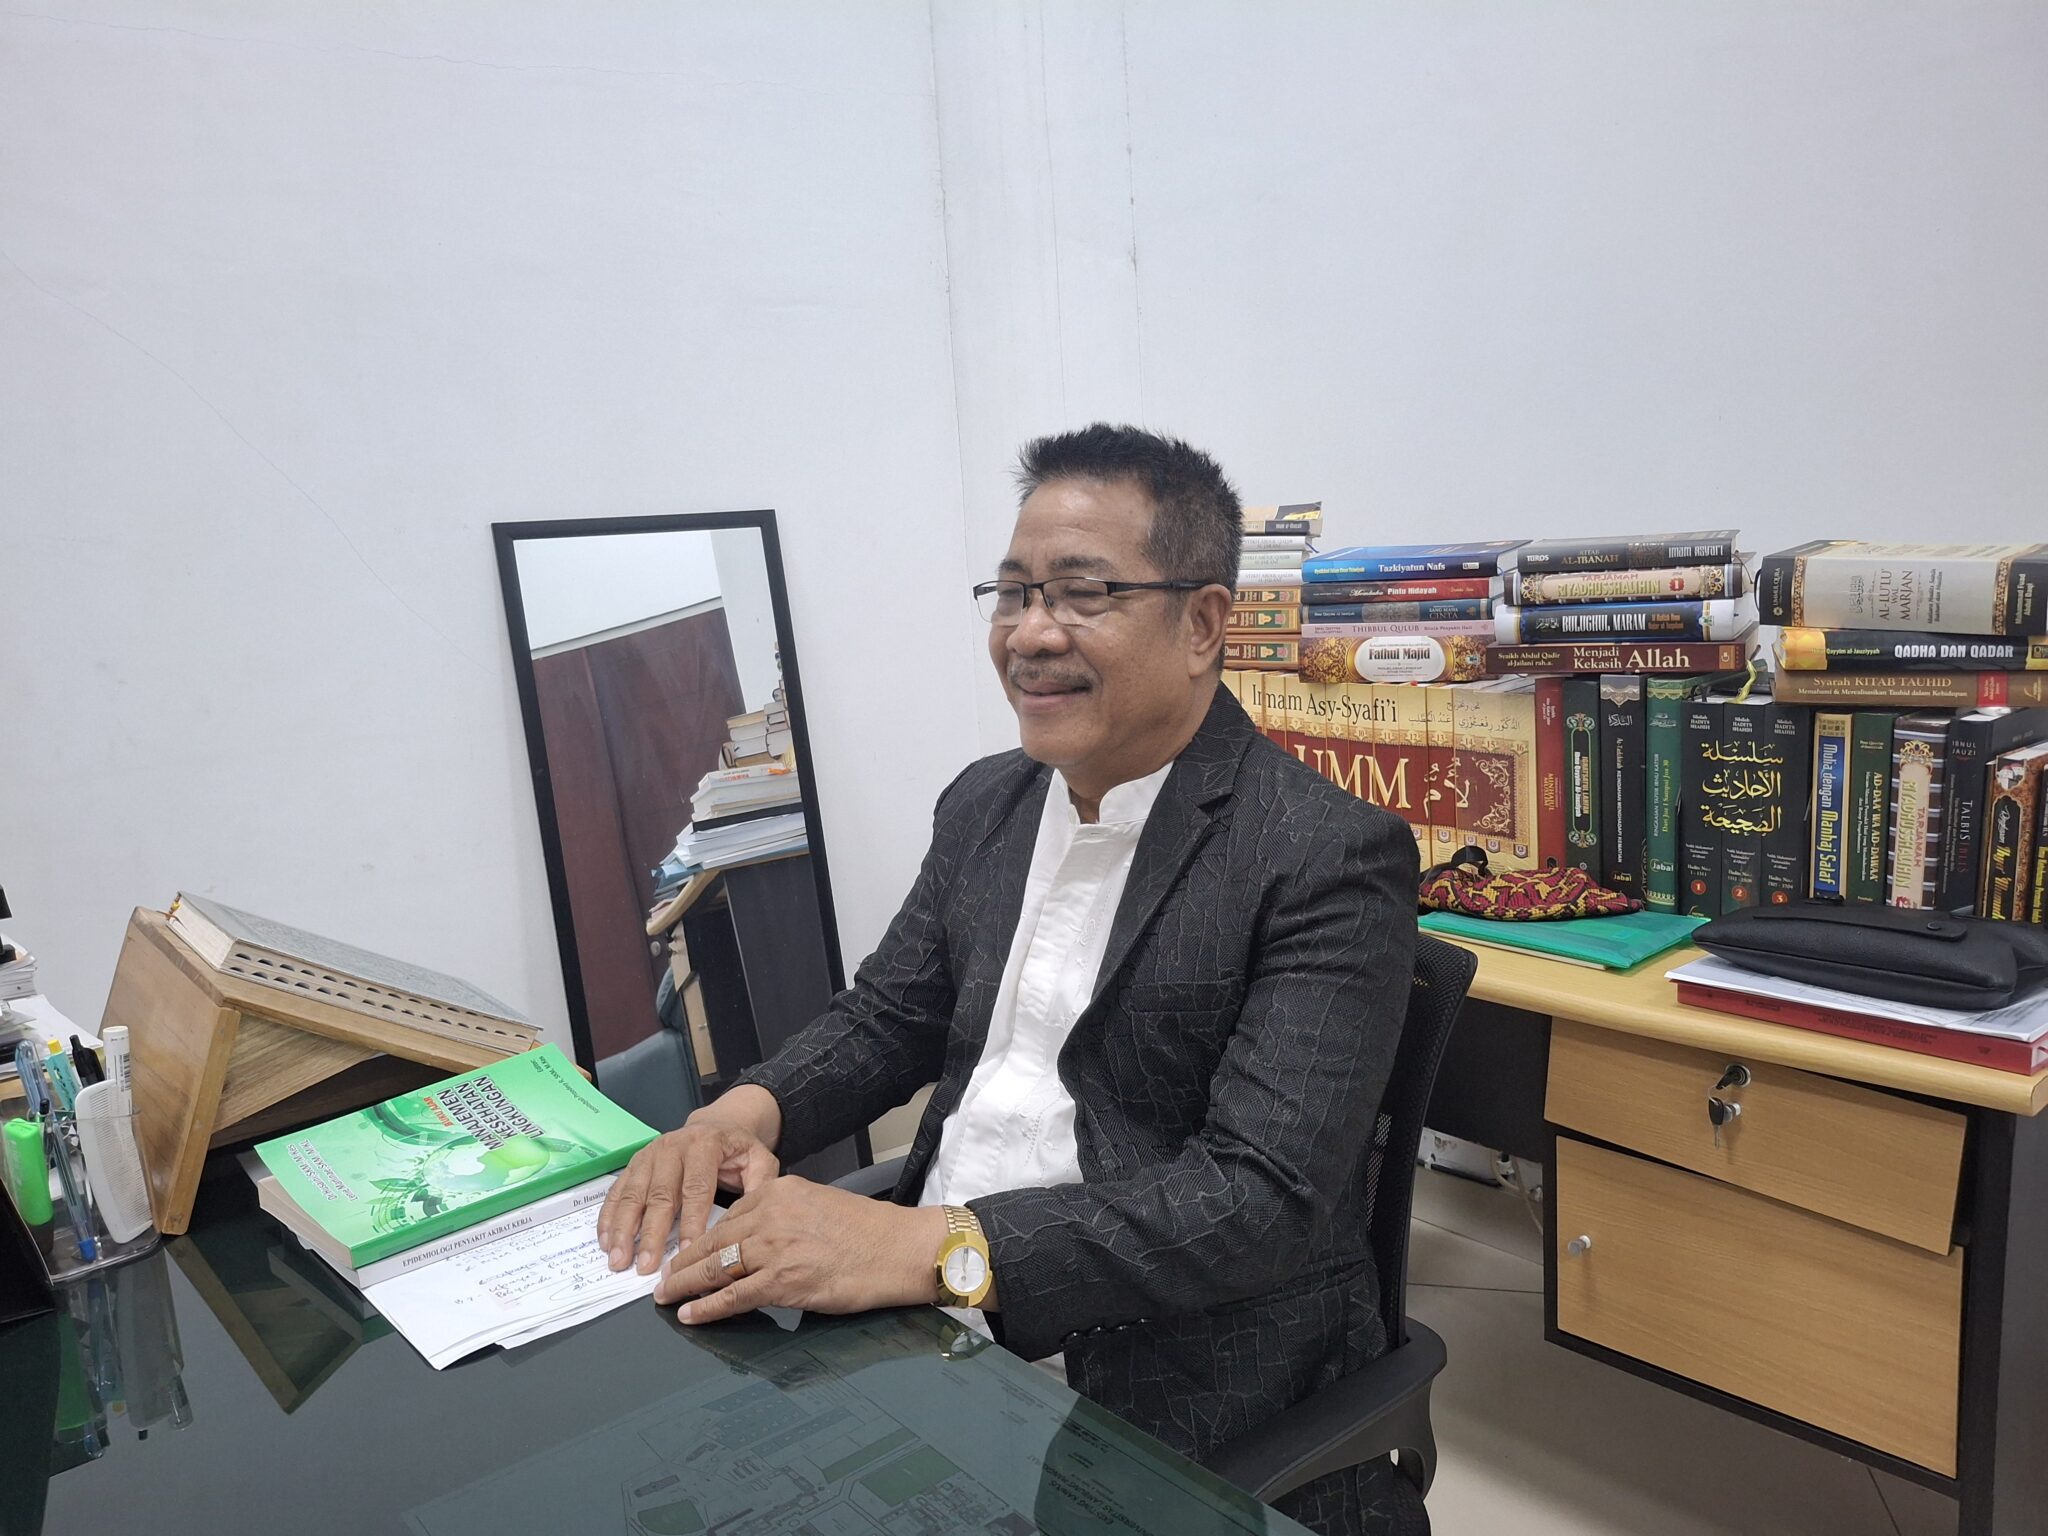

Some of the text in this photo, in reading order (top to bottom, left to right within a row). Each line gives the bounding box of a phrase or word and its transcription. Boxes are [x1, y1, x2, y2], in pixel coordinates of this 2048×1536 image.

[1378, 564, 1424, 573] Tazkiyatun
[1561, 555, 1618, 565] AL-IBANAH
[1582, 573, 1638, 581] TARJAMAH
[1674, 580, 1678, 589] 1
[1408, 587, 1437, 595] Hidayah
[1558, 580, 1660, 597] RIYADHUSSHALIHIN
[1879, 569, 1892, 620] AL-LU'LU'
[1900, 570, 1913, 621] MARJAN
[2015, 589, 2025, 624] Muhammad
[1390, 625, 1420, 633] QULUB
[1562, 614, 1646, 632] BULUGHUL MARAM
[1225, 646, 1240, 657] Daud
[1369, 648, 1430, 660] Fathul Majid
[1574, 647, 1619, 659] Menjadi
[1574, 649, 1690, 669] Kekasih Allah
[1894, 645, 2013, 658] QADHA DAN QADAR
[1813, 677, 1951, 687] Syarah KITAB TAUHID
[1252, 684, 1302, 711] Imam
[1817, 744, 1838, 885] Mulia dengan Manhaj Salaf
[1872, 814, 1881, 827] WA
[1960, 800, 1973, 840] TALBIS
[1895, 780, 1917, 888] RIYADHUSSHALIHIN
[1914, 807, 1926, 867] TARJAMAH
[1652, 860, 1674, 872] Jabal
[1614, 874, 1631, 882] Jabal
[1777, 895, 1783, 903] 3
[424, 1097, 453, 1128] BUKU AJAR
[455, 1082, 518, 1139] KESEHATAN
[474, 1076, 545, 1139] LINGKUNGAN
[437, 1089, 504, 1150] MANAJEMEN
[402, 1243, 453, 1267] EPIDEMIOLOGI
[454, 1228, 486, 1249] PENYAKIT
[487, 1223, 511, 1239] AKIBAT
[511, 1216, 533, 1230] KERJA
[572, 1198, 583, 1207] Dr.
